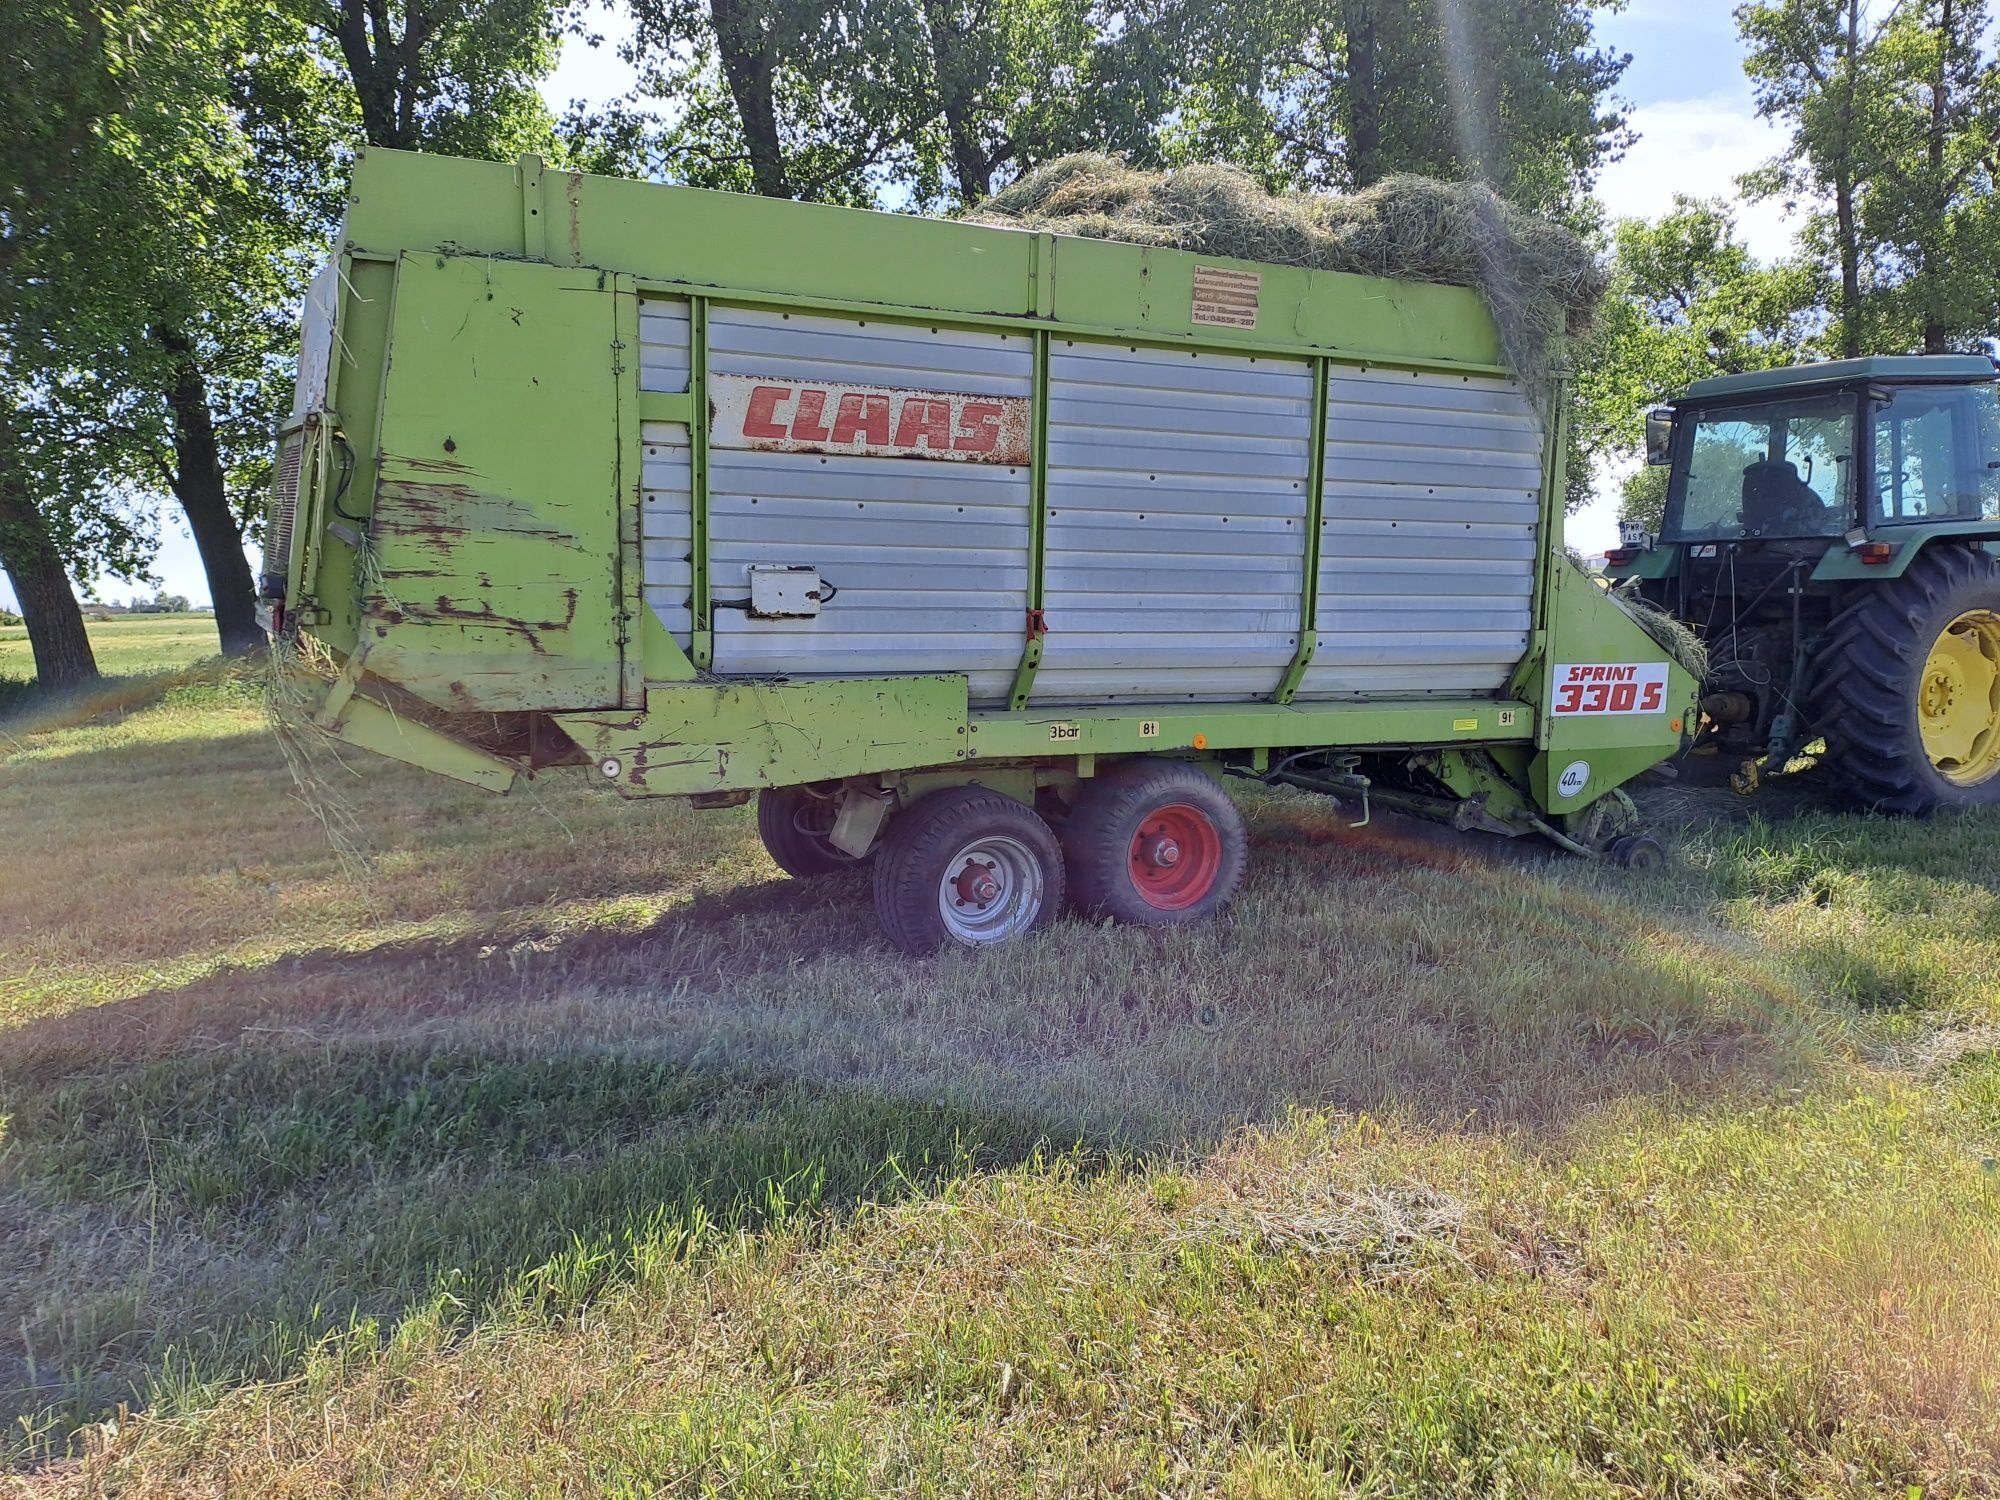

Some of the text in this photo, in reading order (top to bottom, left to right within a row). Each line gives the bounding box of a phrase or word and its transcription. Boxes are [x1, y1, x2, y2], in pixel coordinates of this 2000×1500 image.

[742, 385, 1003, 451] CLAAS
[1626, 523, 1640, 531] PWR
[1568, 666, 1637, 682] SPRINT
[1555, 682, 1664, 713] 330 S
[1502, 712, 1512, 723] 9t
[1143, 722, 1155, 735] 8t
